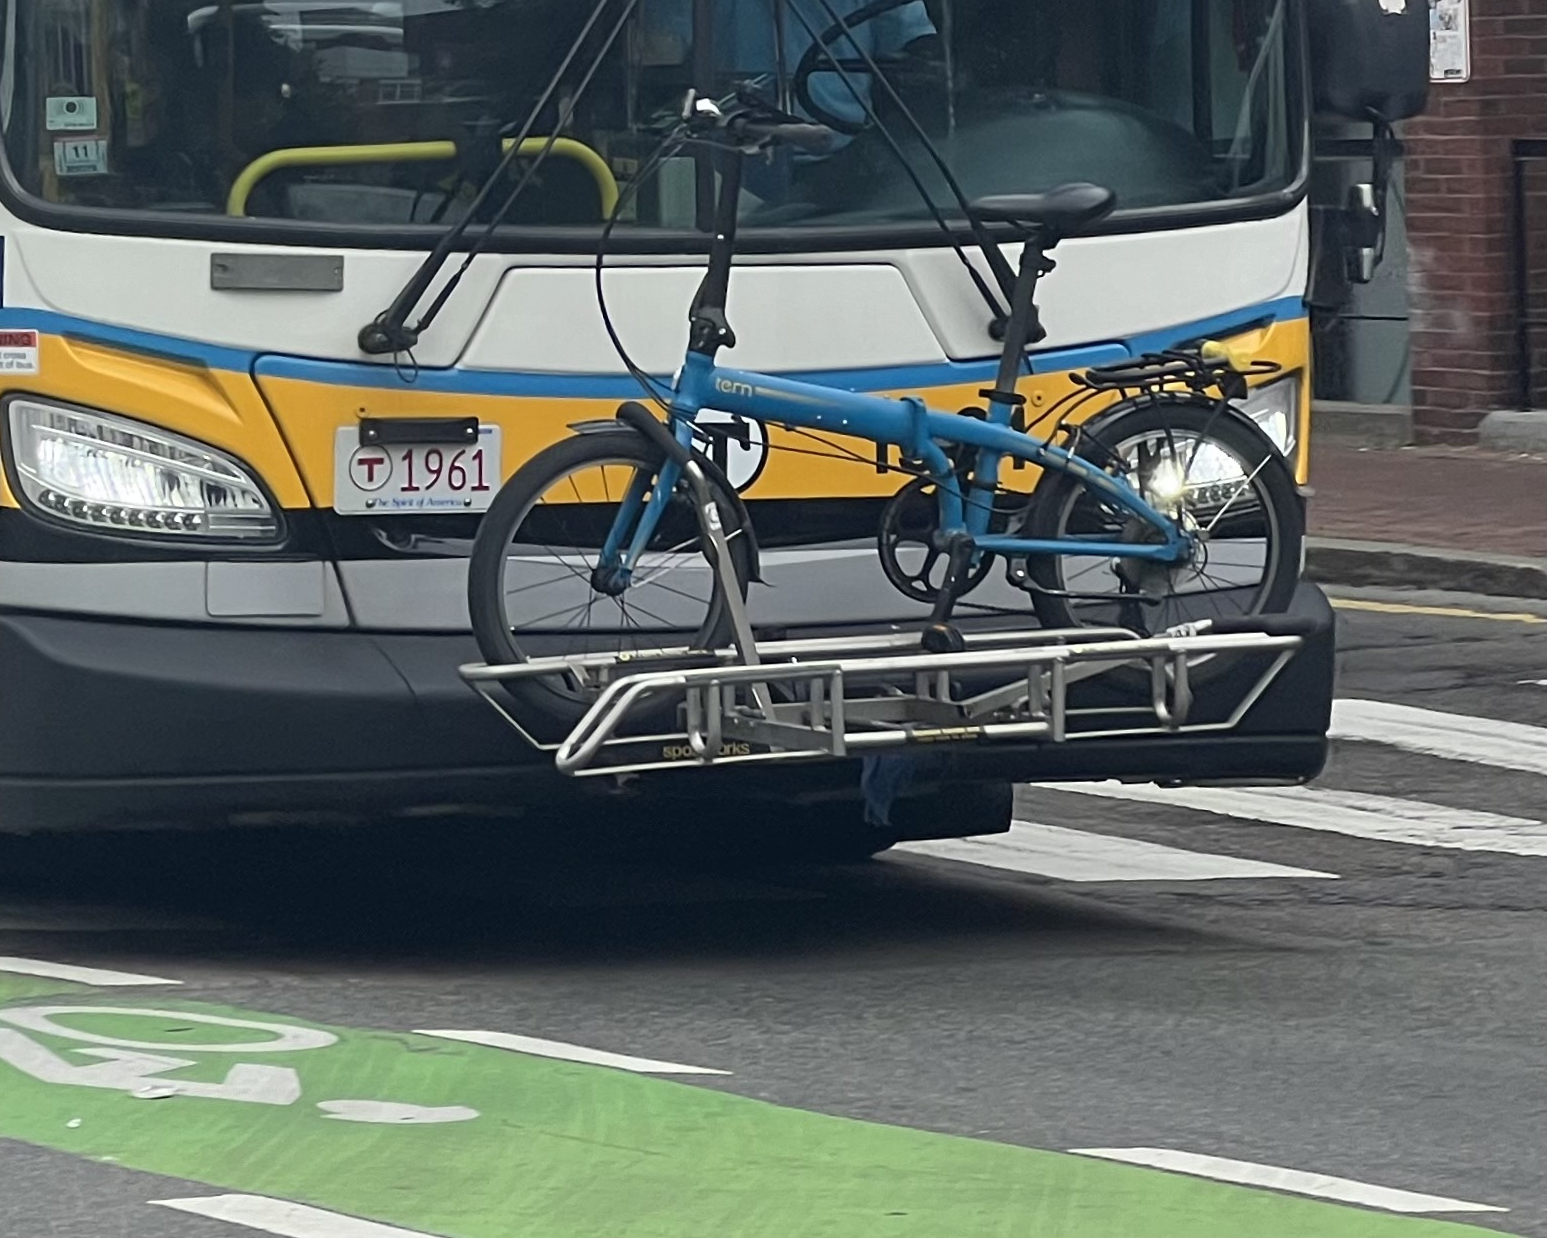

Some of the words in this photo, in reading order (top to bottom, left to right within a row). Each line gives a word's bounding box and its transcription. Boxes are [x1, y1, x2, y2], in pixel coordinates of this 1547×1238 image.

[73, 145, 88, 158] 11
[357, 457, 384, 483] T
[400, 448, 490, 492] 1961
